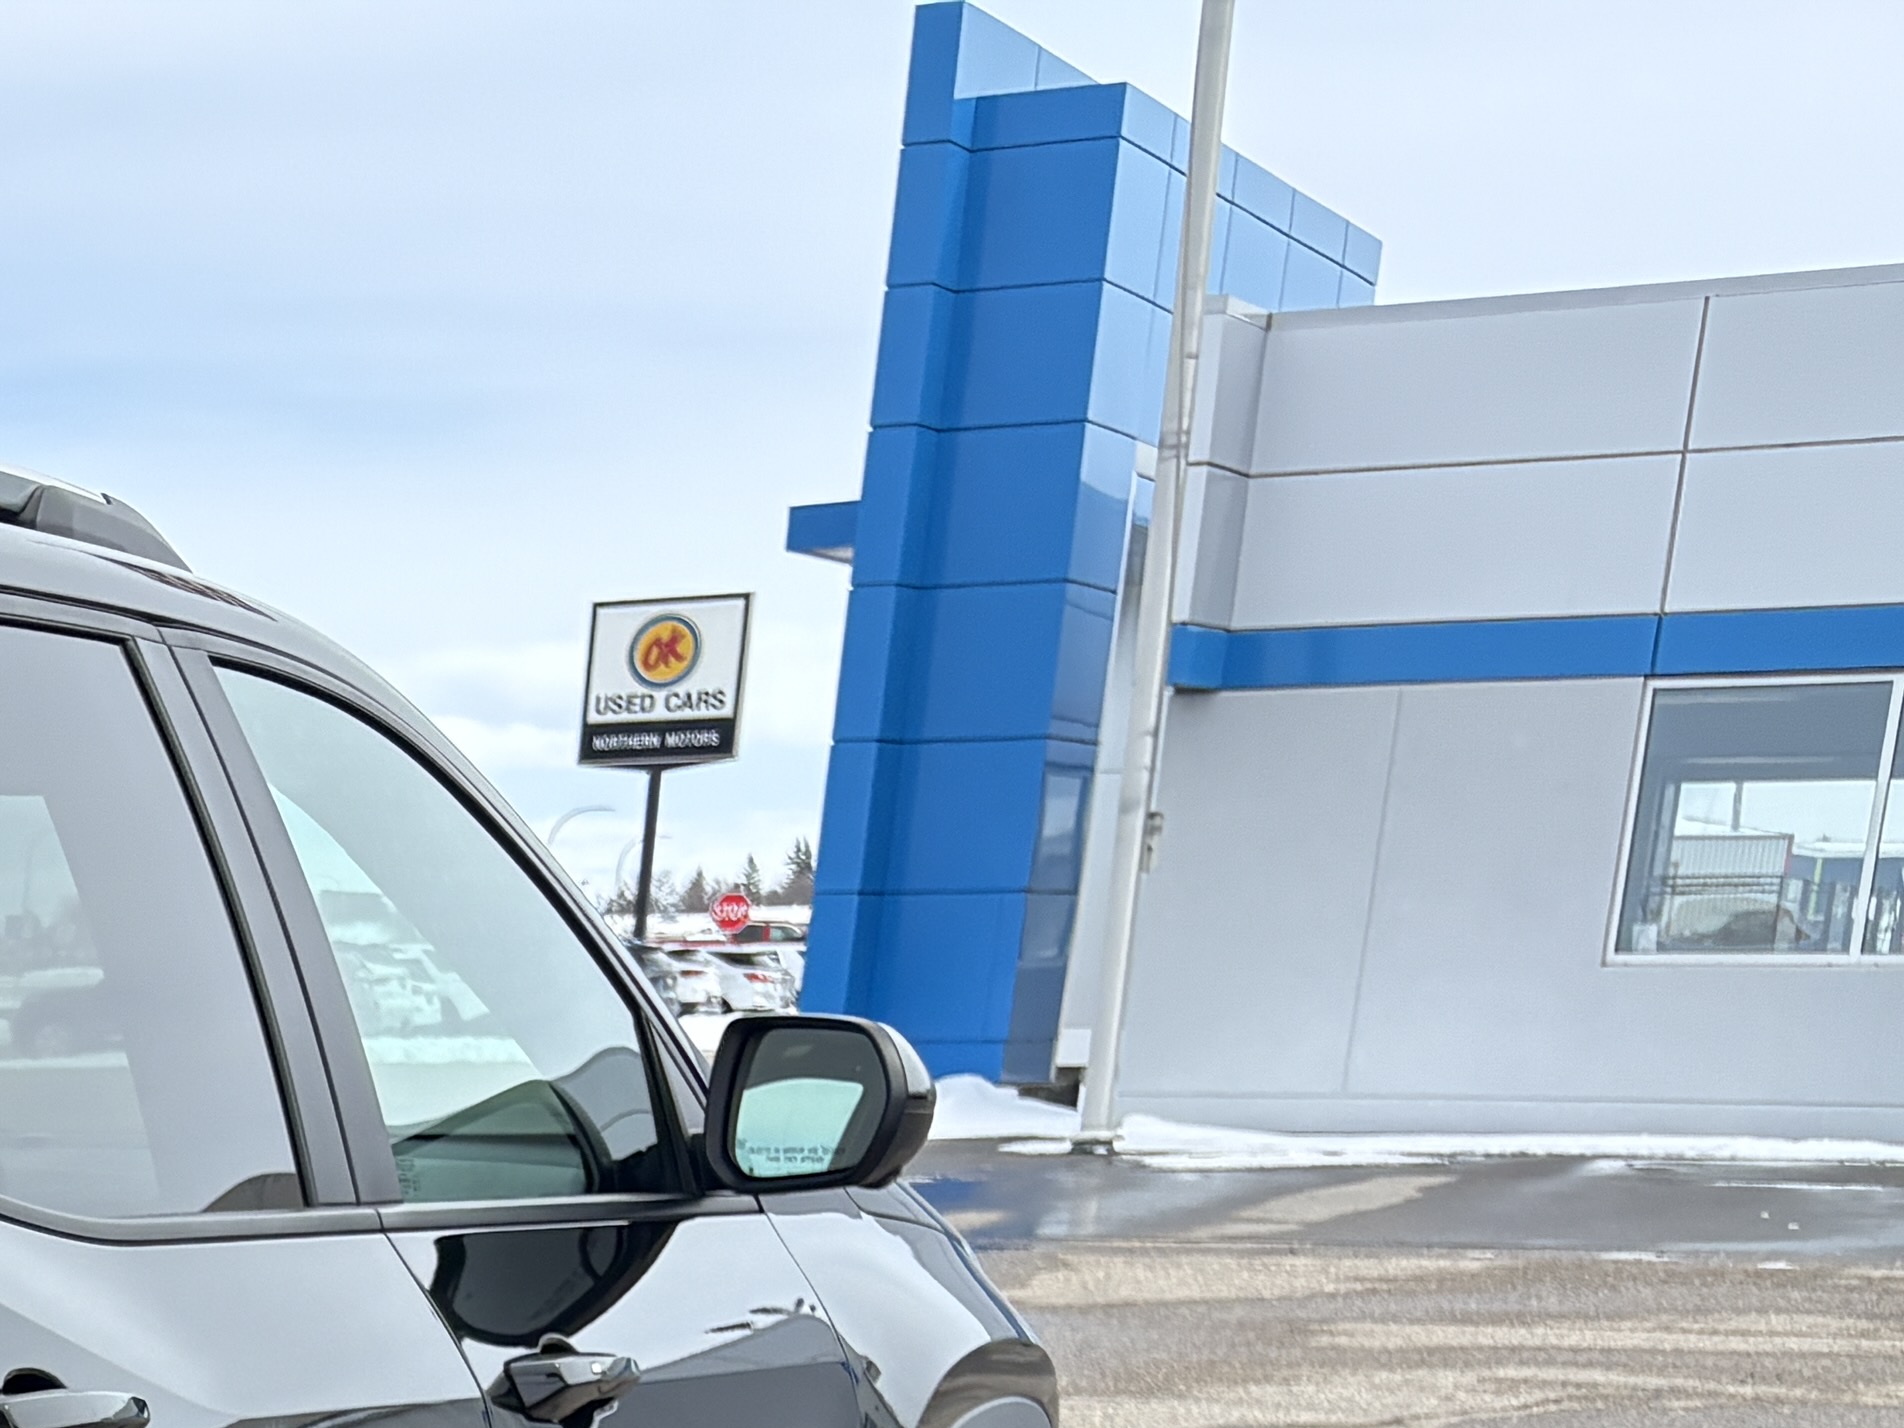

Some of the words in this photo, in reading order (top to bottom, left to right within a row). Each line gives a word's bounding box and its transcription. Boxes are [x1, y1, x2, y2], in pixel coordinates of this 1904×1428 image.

[642, 624, 687, 673] OK
[595, 693, 656, 716] USED
[664, 688, 727, 713] CARS
[592, 731, 661, 751] NORTHERN
[664, 729, 720, 748] MOTORS
